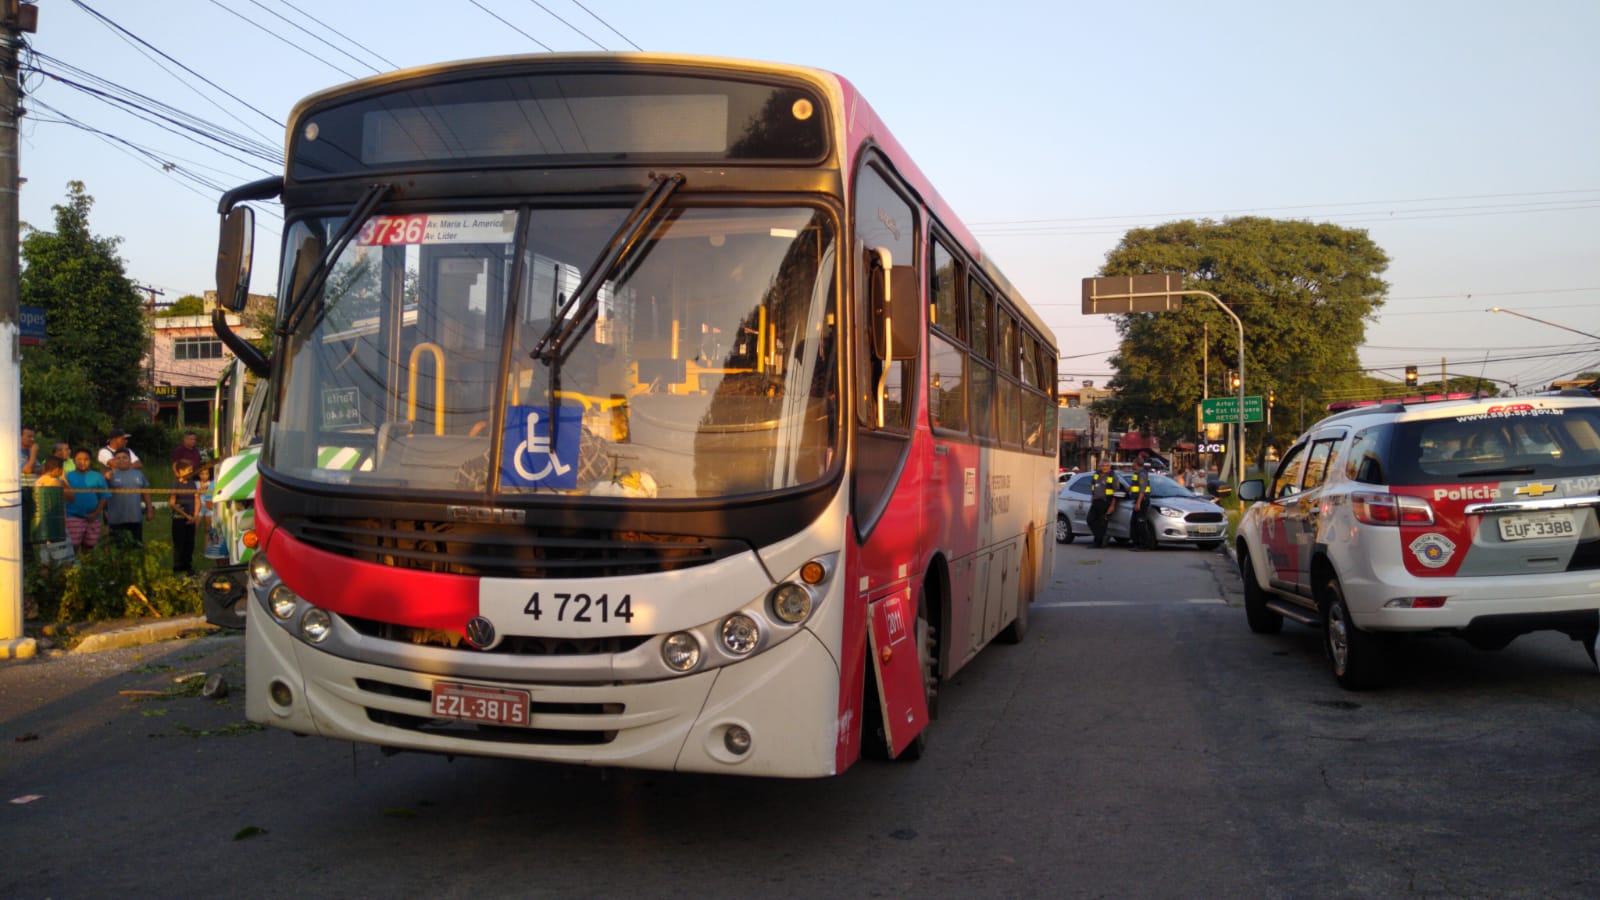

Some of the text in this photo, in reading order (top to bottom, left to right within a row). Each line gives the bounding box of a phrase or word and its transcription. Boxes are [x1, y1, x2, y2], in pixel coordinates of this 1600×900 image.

[360, 217, 422, 245] 3736
[440, 219, 461, 229] Maria
[20, 312, 46, 327] opes
[1456, 408, 1564, 423] www.ssp.sp.gov.br
[1561, 477, 1600, 492] T-02
[1433, 485, 1502, 501] Polícia
[523, 592, 634, 623] 4 7214
[887, 609, 903, 635] 2011
